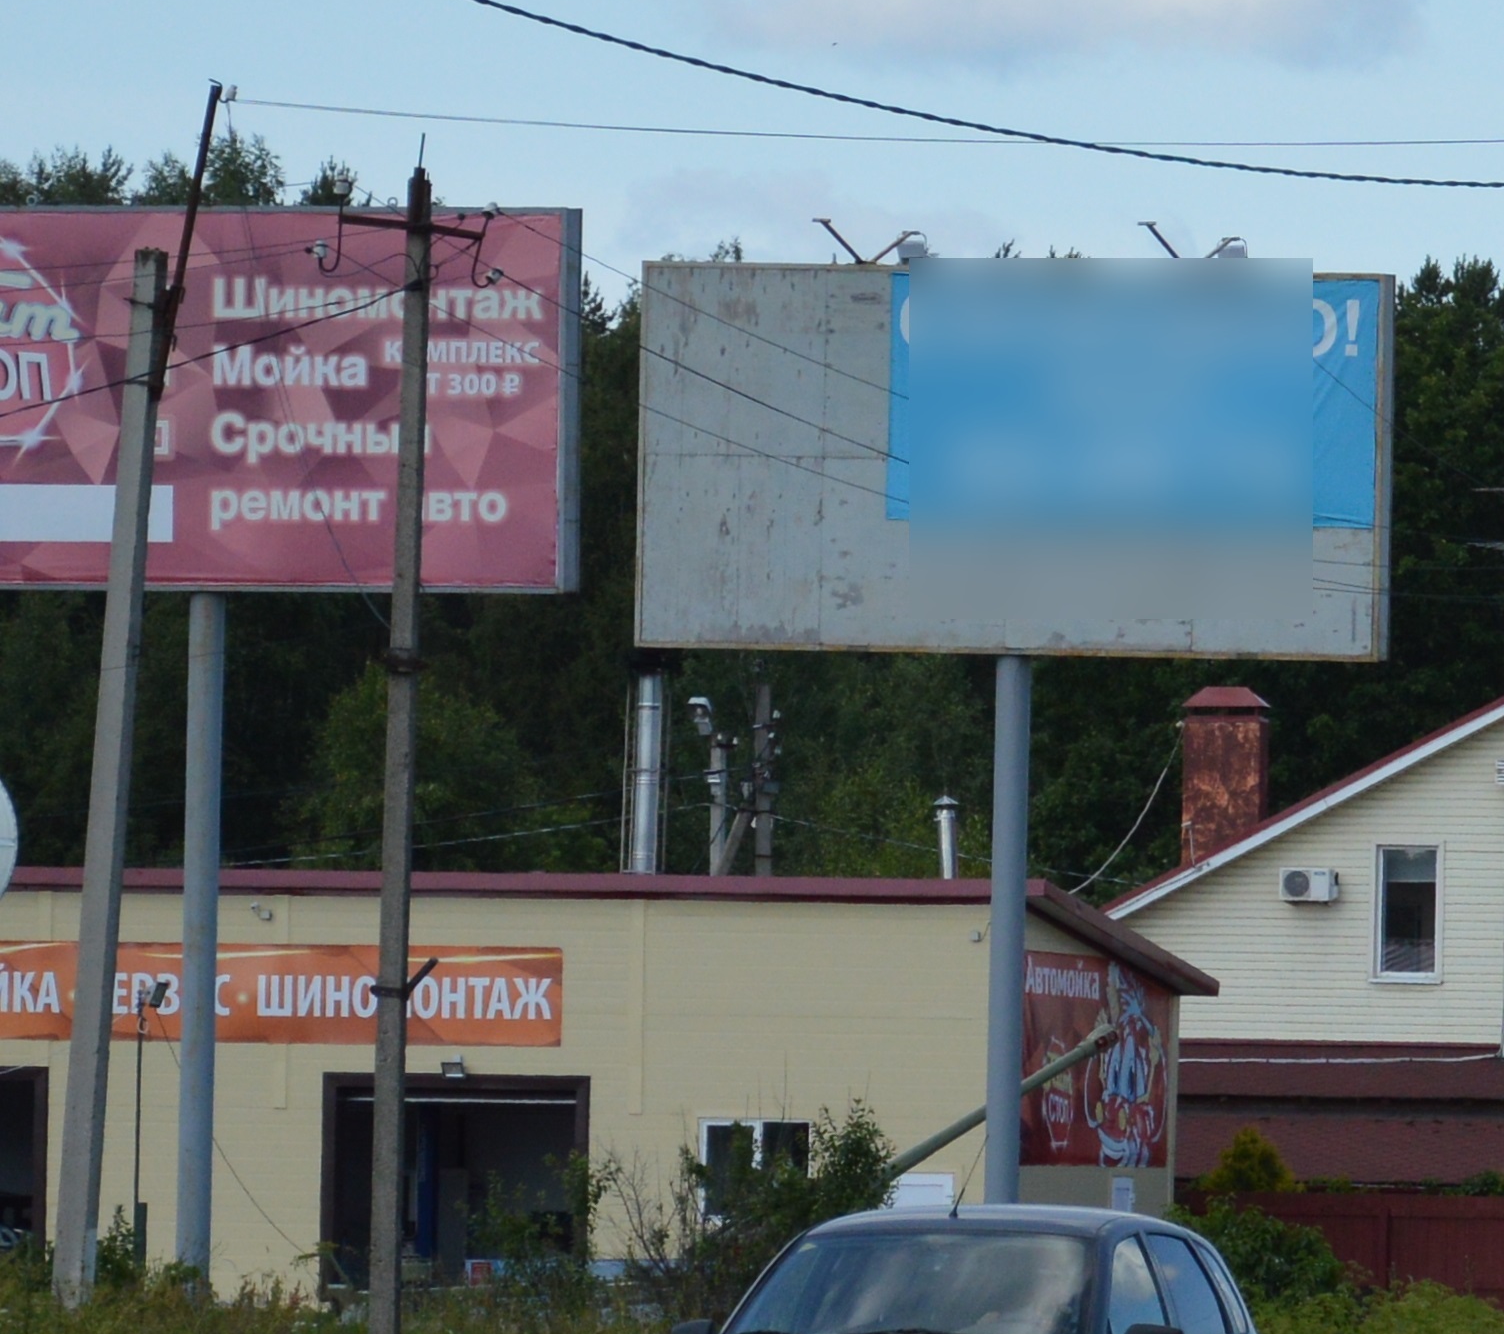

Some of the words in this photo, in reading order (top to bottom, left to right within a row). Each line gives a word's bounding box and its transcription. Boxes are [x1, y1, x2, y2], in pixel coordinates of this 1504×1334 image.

[213, 344, 366, 389] Мойка
[385, 341, 540, 363] КМПЛЕКС
[448, 374, 496, 395] 300
[210, 489, 386, 531] ремонт
[422, 491, 507, 522] вто
[257, 975, 552, 1020] ШИНООНТАЖ
